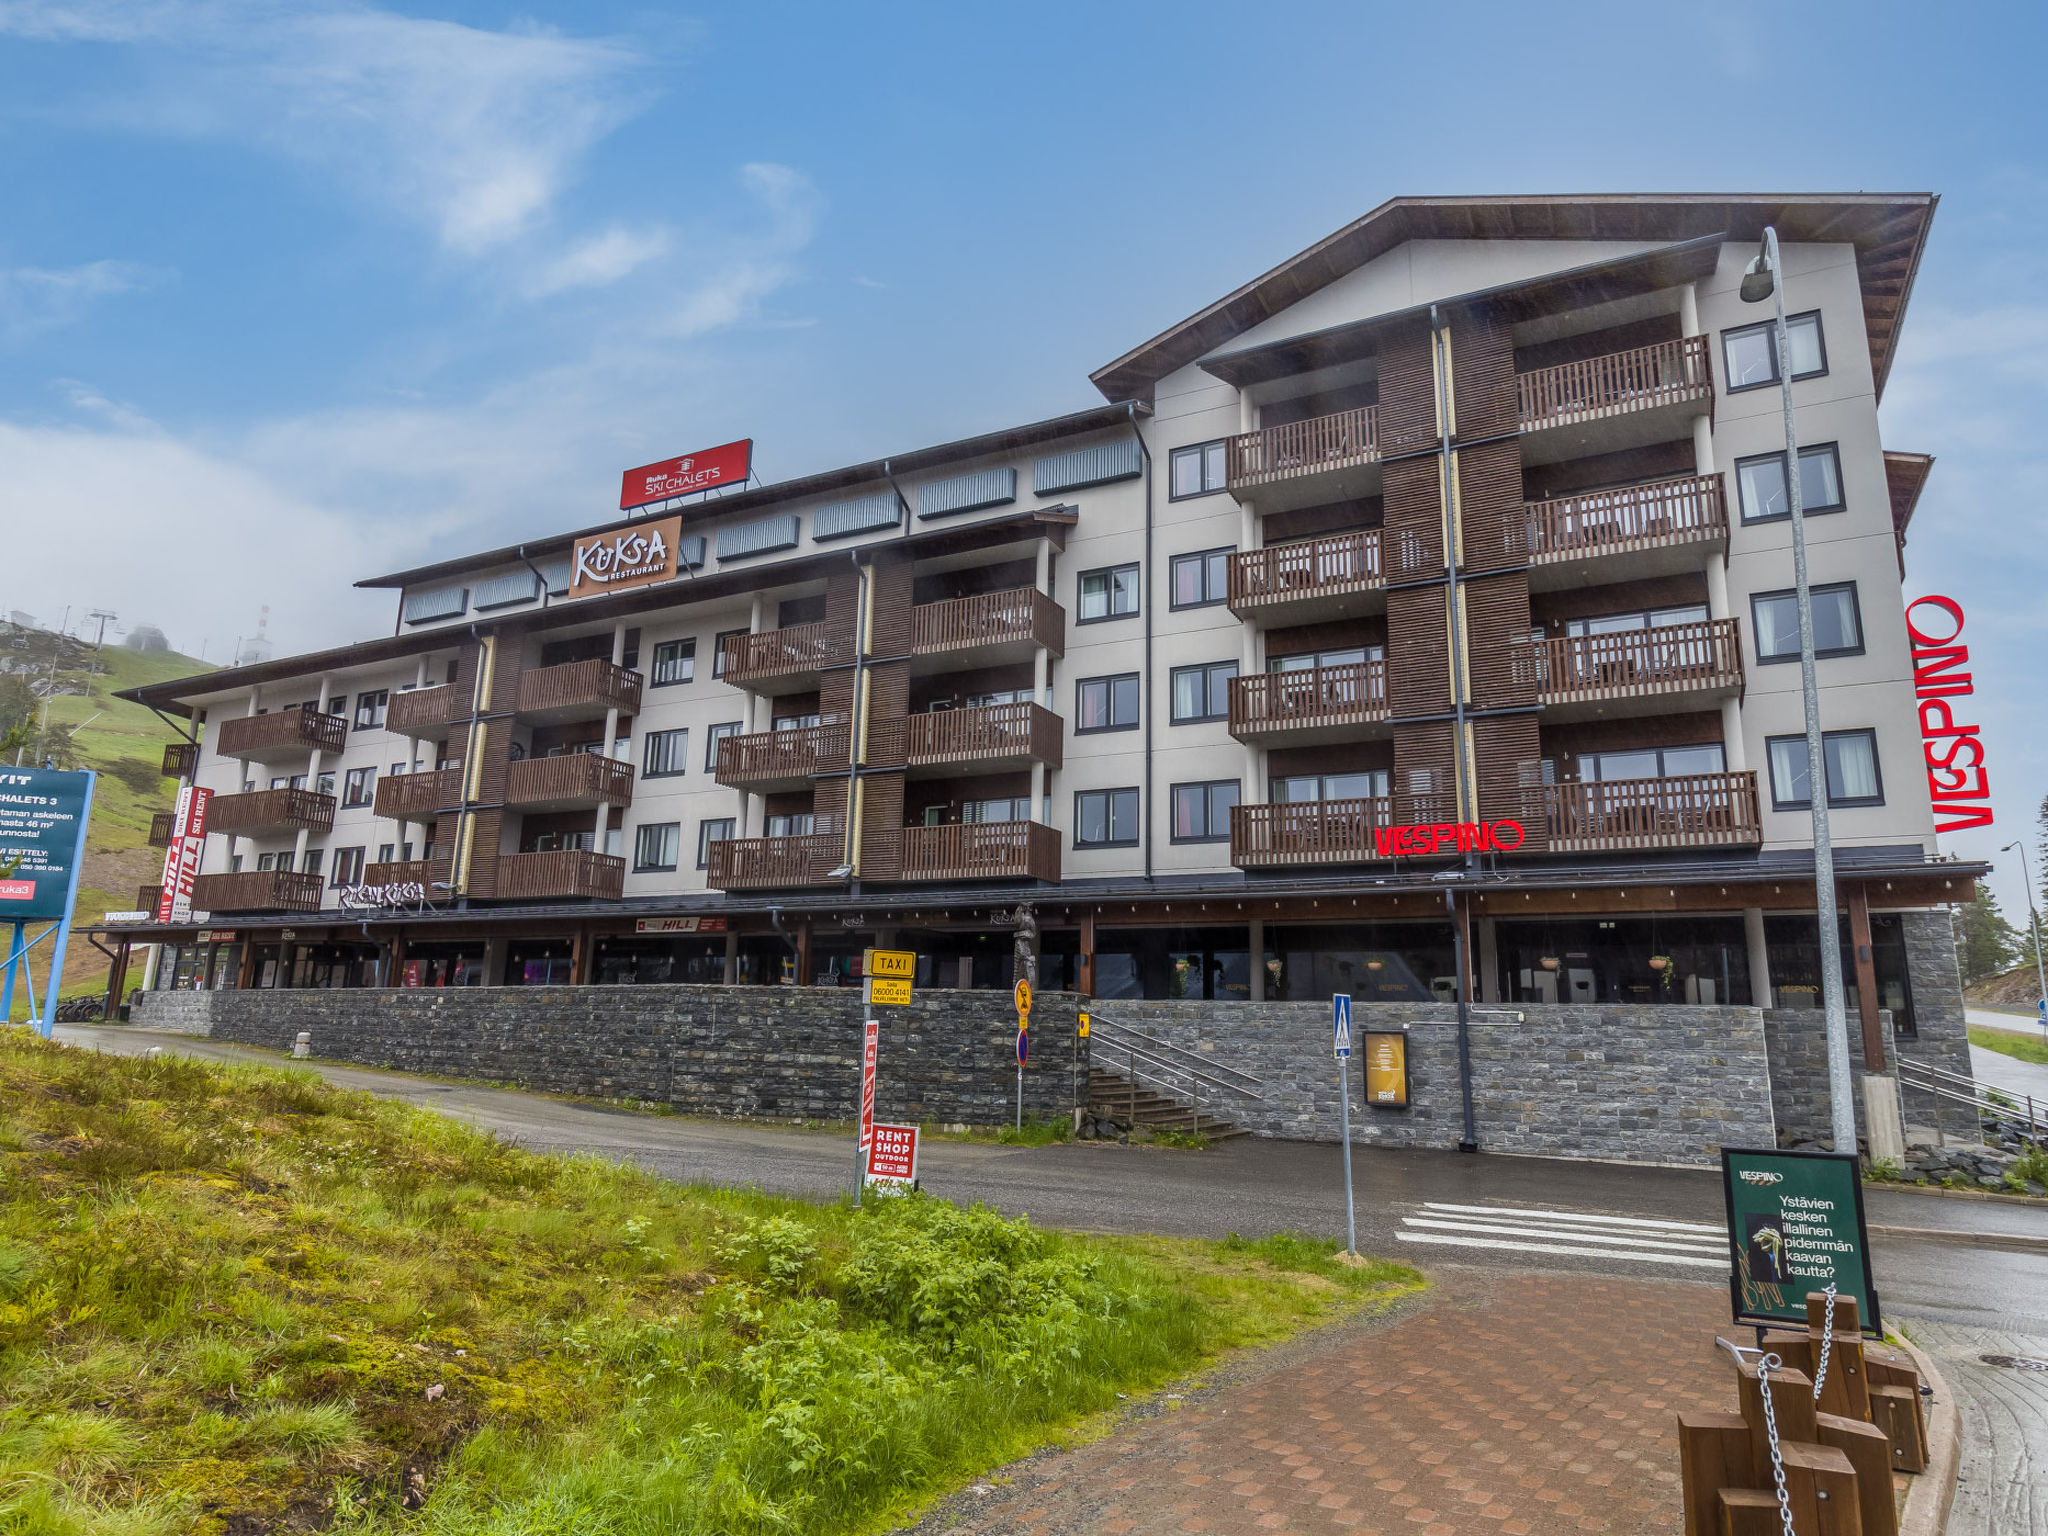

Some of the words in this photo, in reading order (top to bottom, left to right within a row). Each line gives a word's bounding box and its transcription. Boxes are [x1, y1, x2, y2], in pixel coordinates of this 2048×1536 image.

[645, 482, 664, 495] SKI
[665, 466, 720, 489] CHALETS
[610, 563, 665, 580] RESTAURANT
[1905, 595, 1994, 833] VESPINO
[0, 794, 47, 805] HALETS
[195, 790, 207, 817] RENT
[33, 811, 74, 820] askeleen
[26, 820, 39, 828] 46
[192, 818, 202, 835] SKI
[1374, 819, 1525, 856] VESPINO
[165, 839, 182, 897] HILL
[178, 841, 200, 898] HILL
[662, 919, 693, 931] HILL
[880, 957, 907, 970] TAXI
[877, 1130, 911, 1143] RENT
[876, 1142, 910, 1154] SHOP
[875, 1153, 909, 1162] OUTDOOR
[1739, 1170, 1784, 1182] VESPINO
[1779, 1195, 1834, 1210] Ystävien
[1780, 1209, 1827, 1223] kesken
[1782, 1222, 1833, 1237] illallinen
[1784, 1236, 1853, 1252] pidemmän
[1785, 1250, 1832, 1264] kaavan
[1787, 1263, 1835, 1278] kautta?
